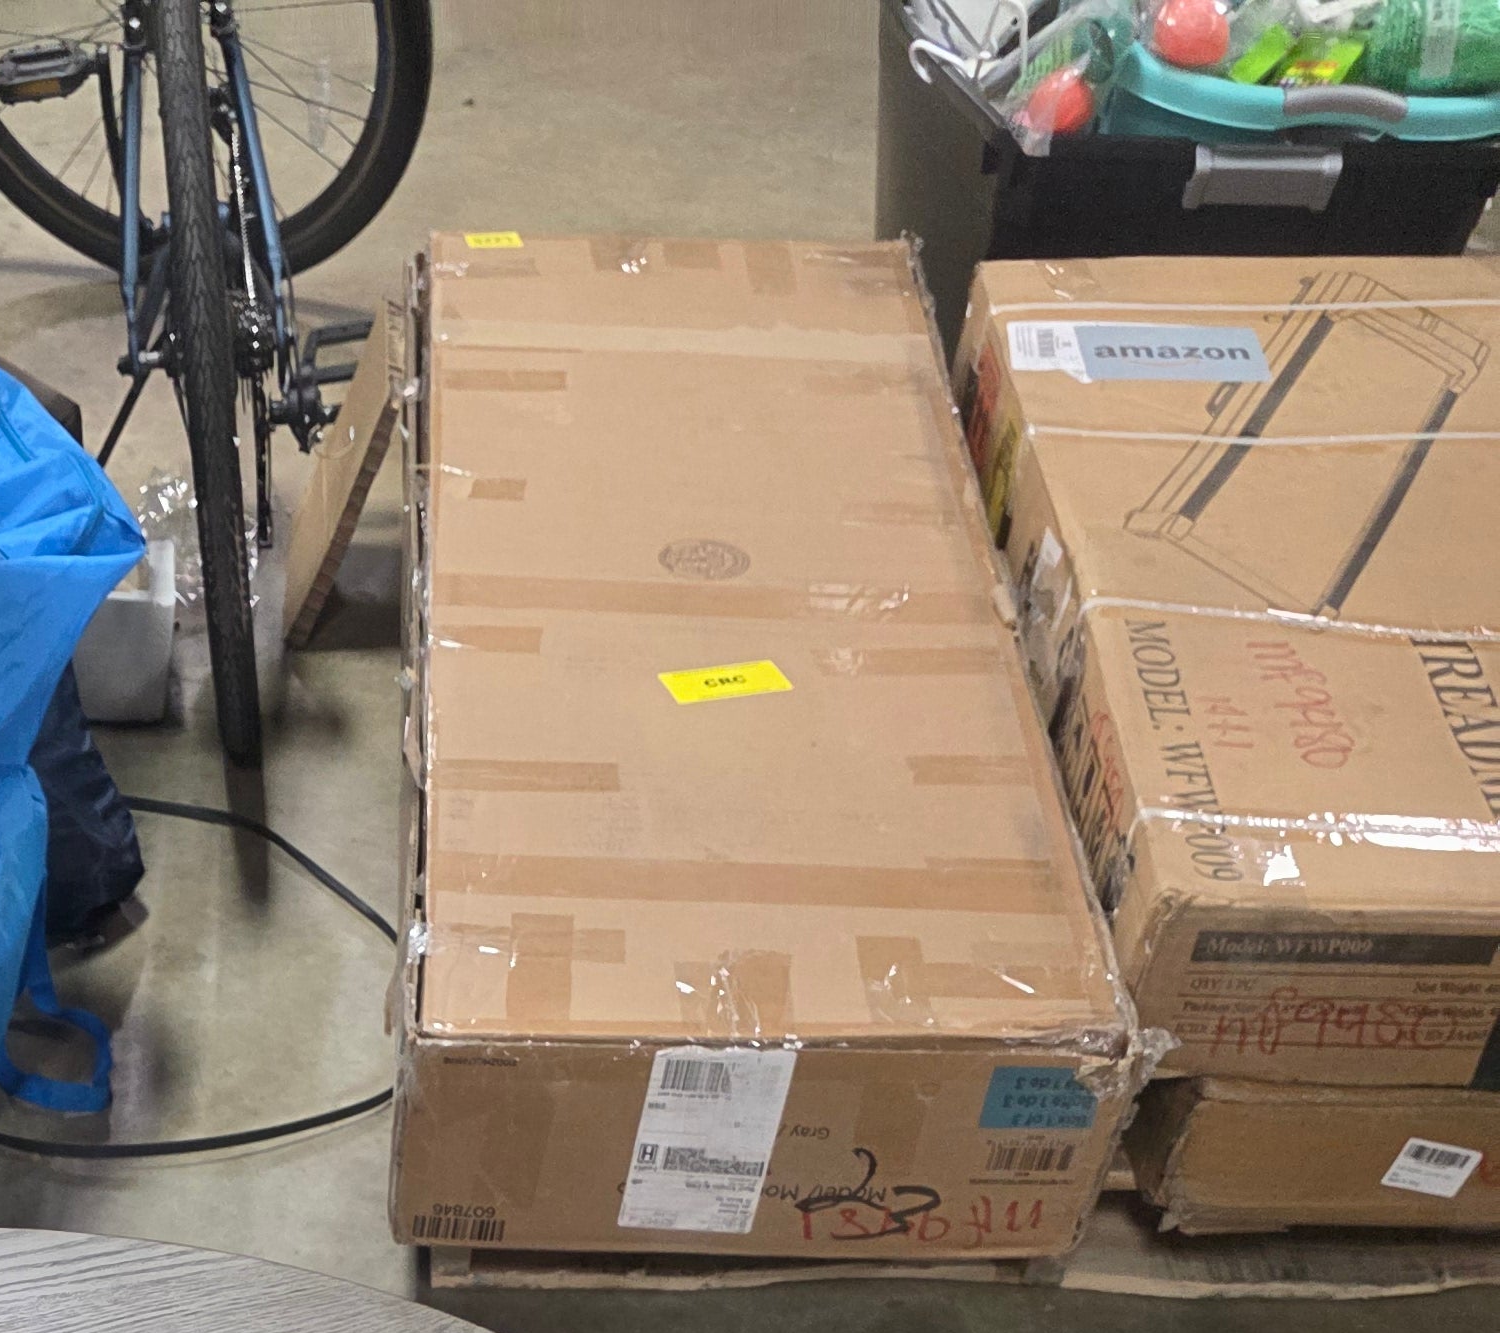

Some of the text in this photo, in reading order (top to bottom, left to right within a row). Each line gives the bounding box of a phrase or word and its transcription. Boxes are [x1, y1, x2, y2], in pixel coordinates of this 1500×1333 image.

[1093, 344, 1251, 361] amazon
[1124, 618, 1192, 732] MODEL:
[1206, 935, 1373, 954] Model: WFWP009
[1002, 1095, 1013, 1109] 3
[1017, 1095, 1038, 1109] de
[789, 1124, 831, 1141] Gray
[431, 1202, 496, 1218] 607846
